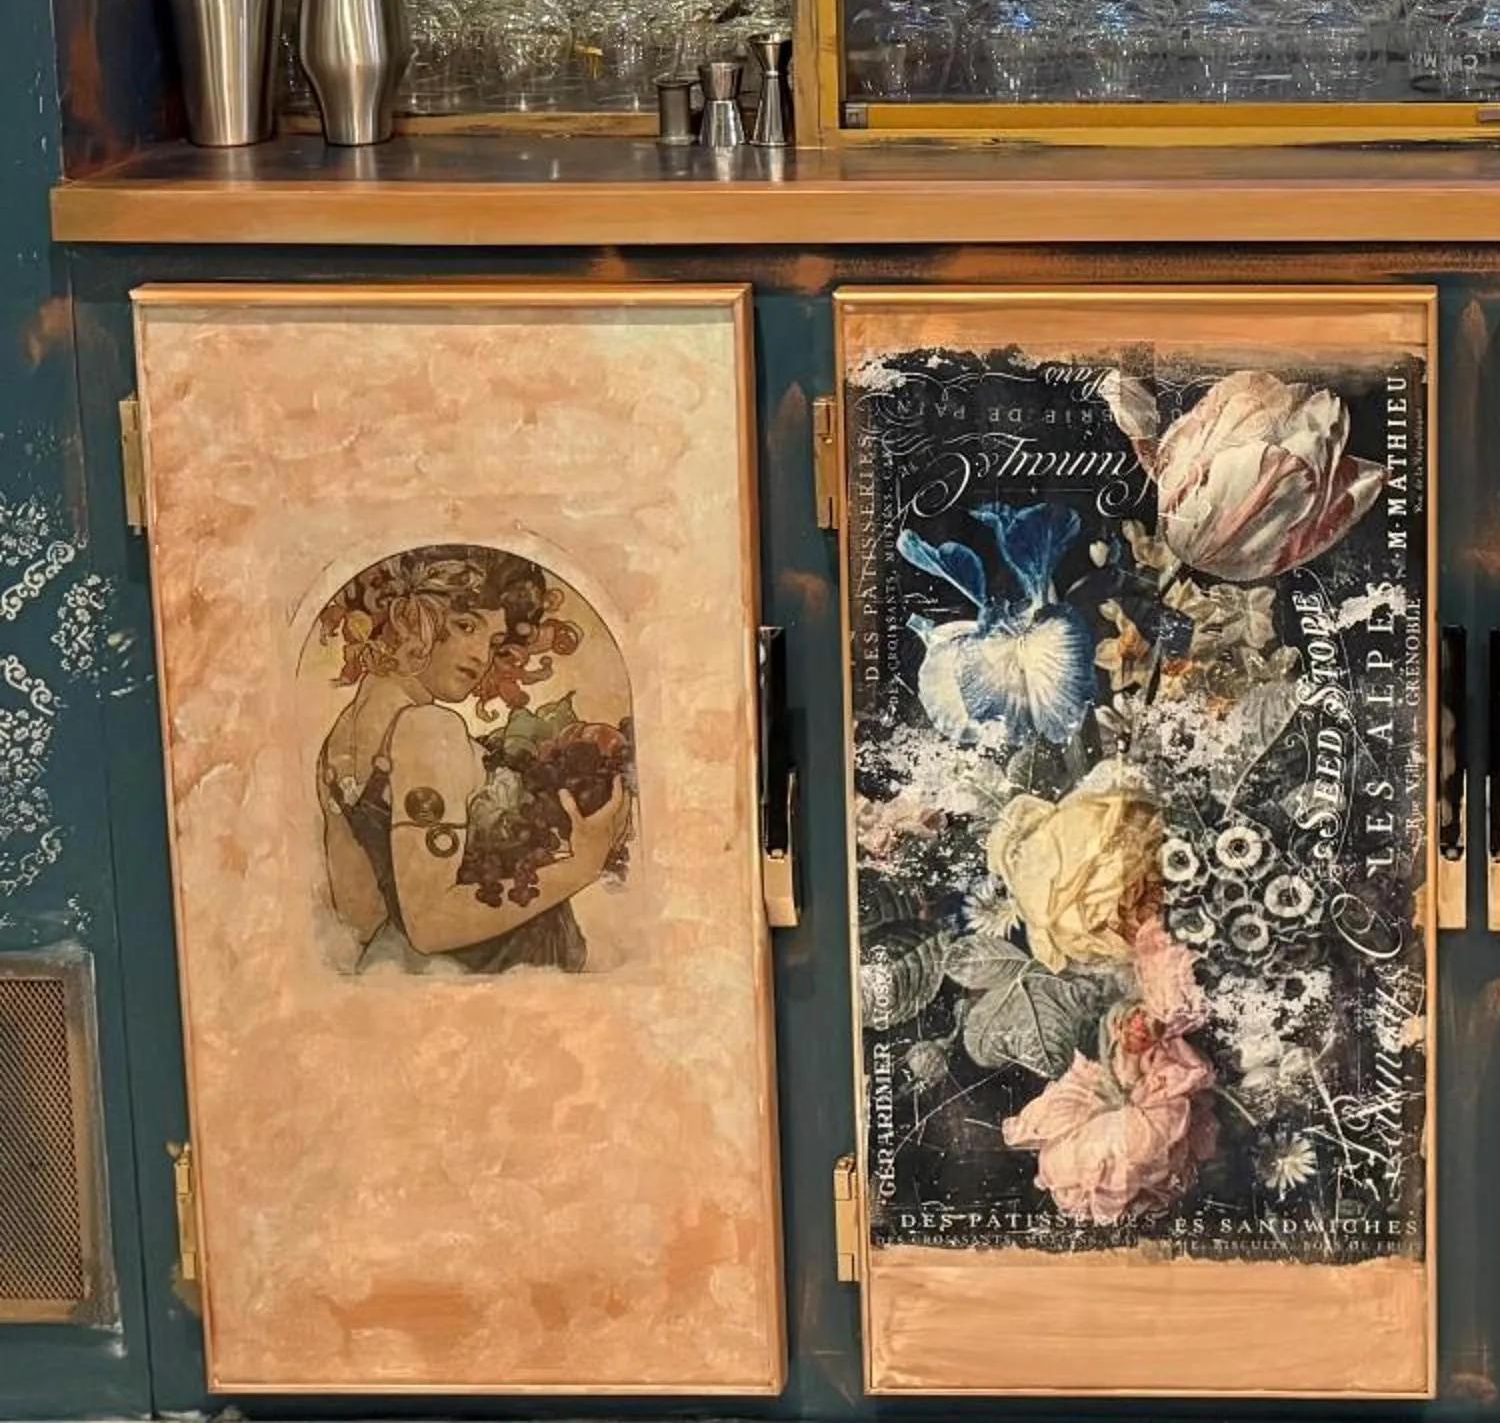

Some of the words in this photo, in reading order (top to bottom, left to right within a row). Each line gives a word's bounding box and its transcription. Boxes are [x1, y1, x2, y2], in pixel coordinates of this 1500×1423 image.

[863, 630, 880, 681] DES
[1404, 598, 1422, 707] GRENOBLE
[1296, 727, 1345, 840] SEED
[1366, 779, 1395, 870] LES
[900, 1214, 954, 1229] DES
